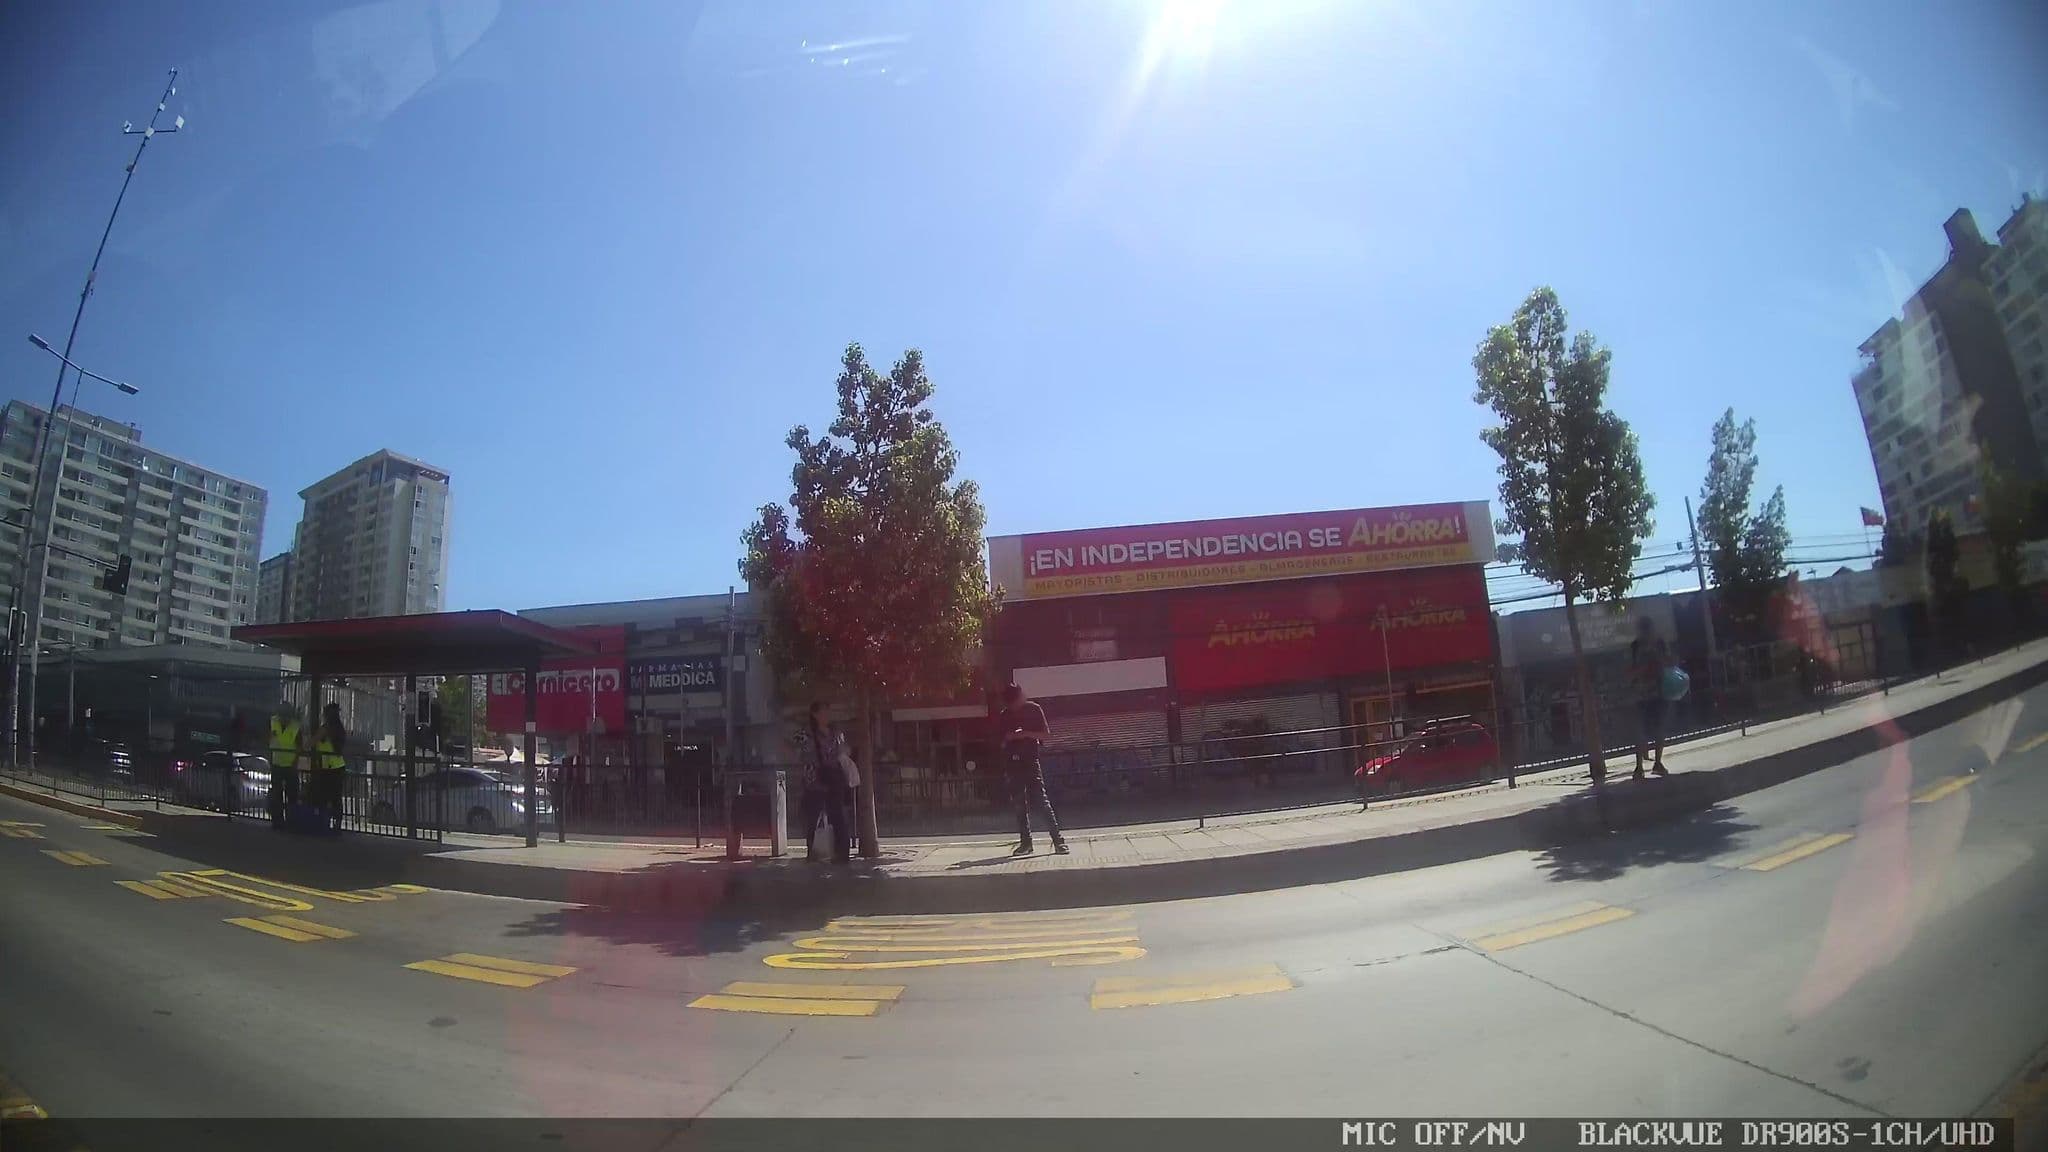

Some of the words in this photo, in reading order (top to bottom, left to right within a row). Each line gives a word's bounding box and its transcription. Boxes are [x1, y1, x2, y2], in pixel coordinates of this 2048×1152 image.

[1030, 549, 1074, 575] ¡EN
[1081, 528, 1302, 566] INDEPENDENCIA
[1308, 525, 1343, 548] SE
[1034, 573, 1121, 593] MAYORISTAS
[649, 670, 715, 689] MEDDICA
